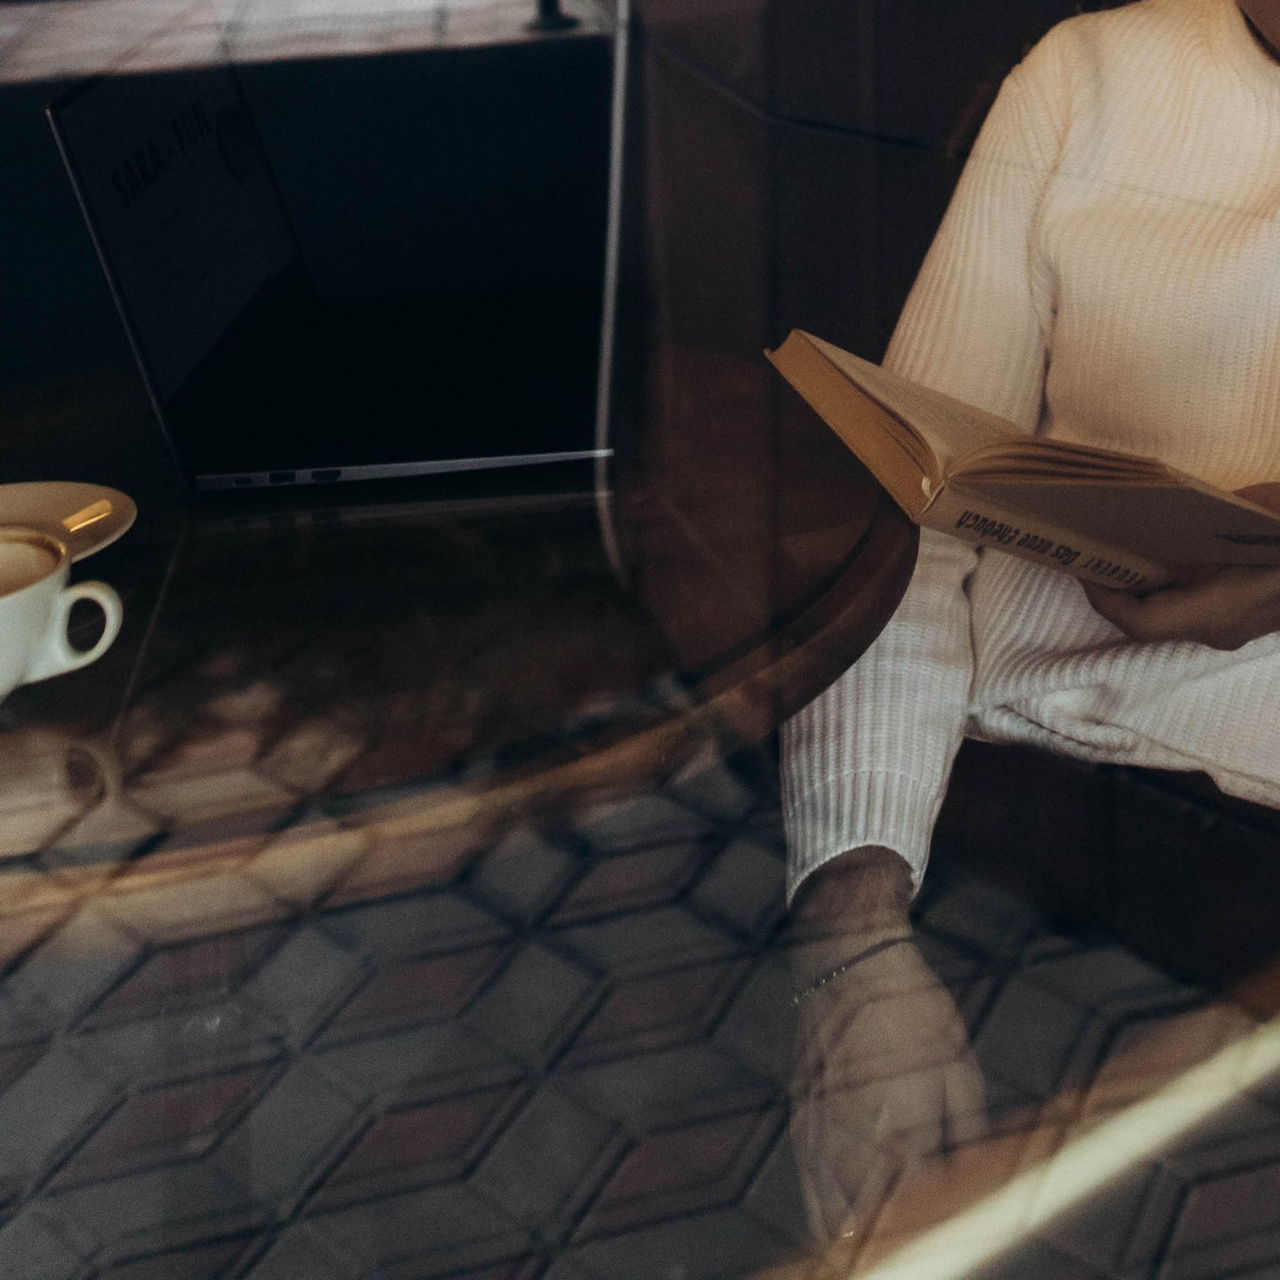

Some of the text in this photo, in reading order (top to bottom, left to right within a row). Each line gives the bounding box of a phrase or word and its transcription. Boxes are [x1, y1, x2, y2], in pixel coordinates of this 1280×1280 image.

[955, 510, 1020, 545] Ehebuch
[1017, 532, 1054, 554] neue
[1050, 544, 1081, 566] Das
